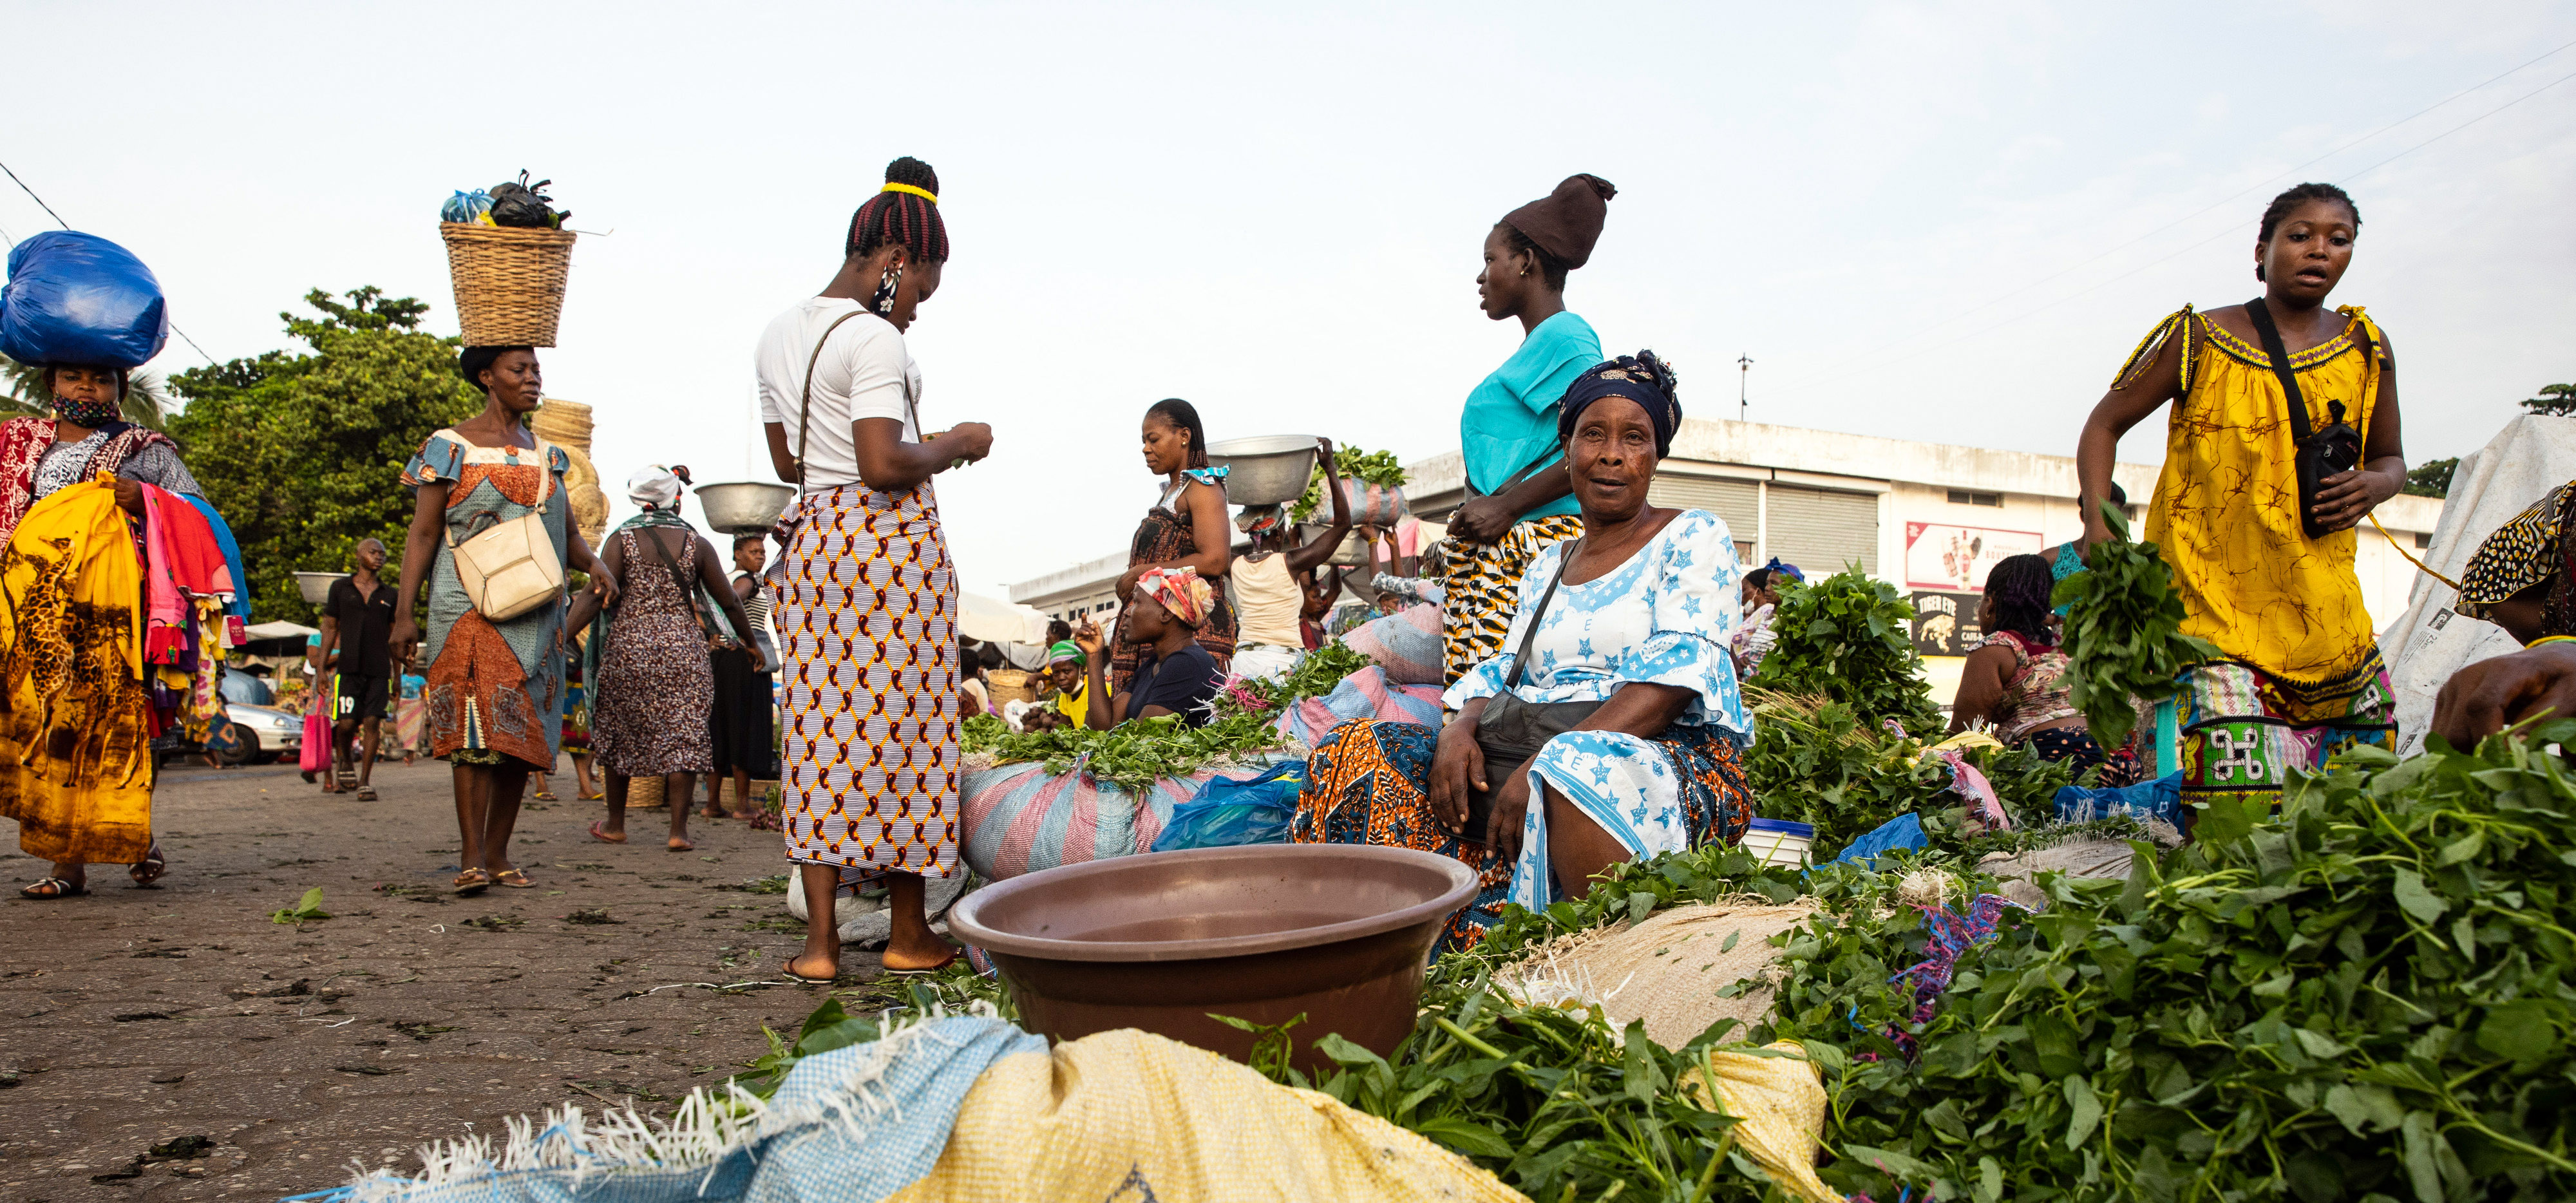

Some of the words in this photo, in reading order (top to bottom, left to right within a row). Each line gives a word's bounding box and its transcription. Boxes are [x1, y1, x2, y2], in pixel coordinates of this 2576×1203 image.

[1918, 595, 1942, 614] TIGER
[1942, 596, 1956, 616] EYE
[339, 696, 354, 714] 19
